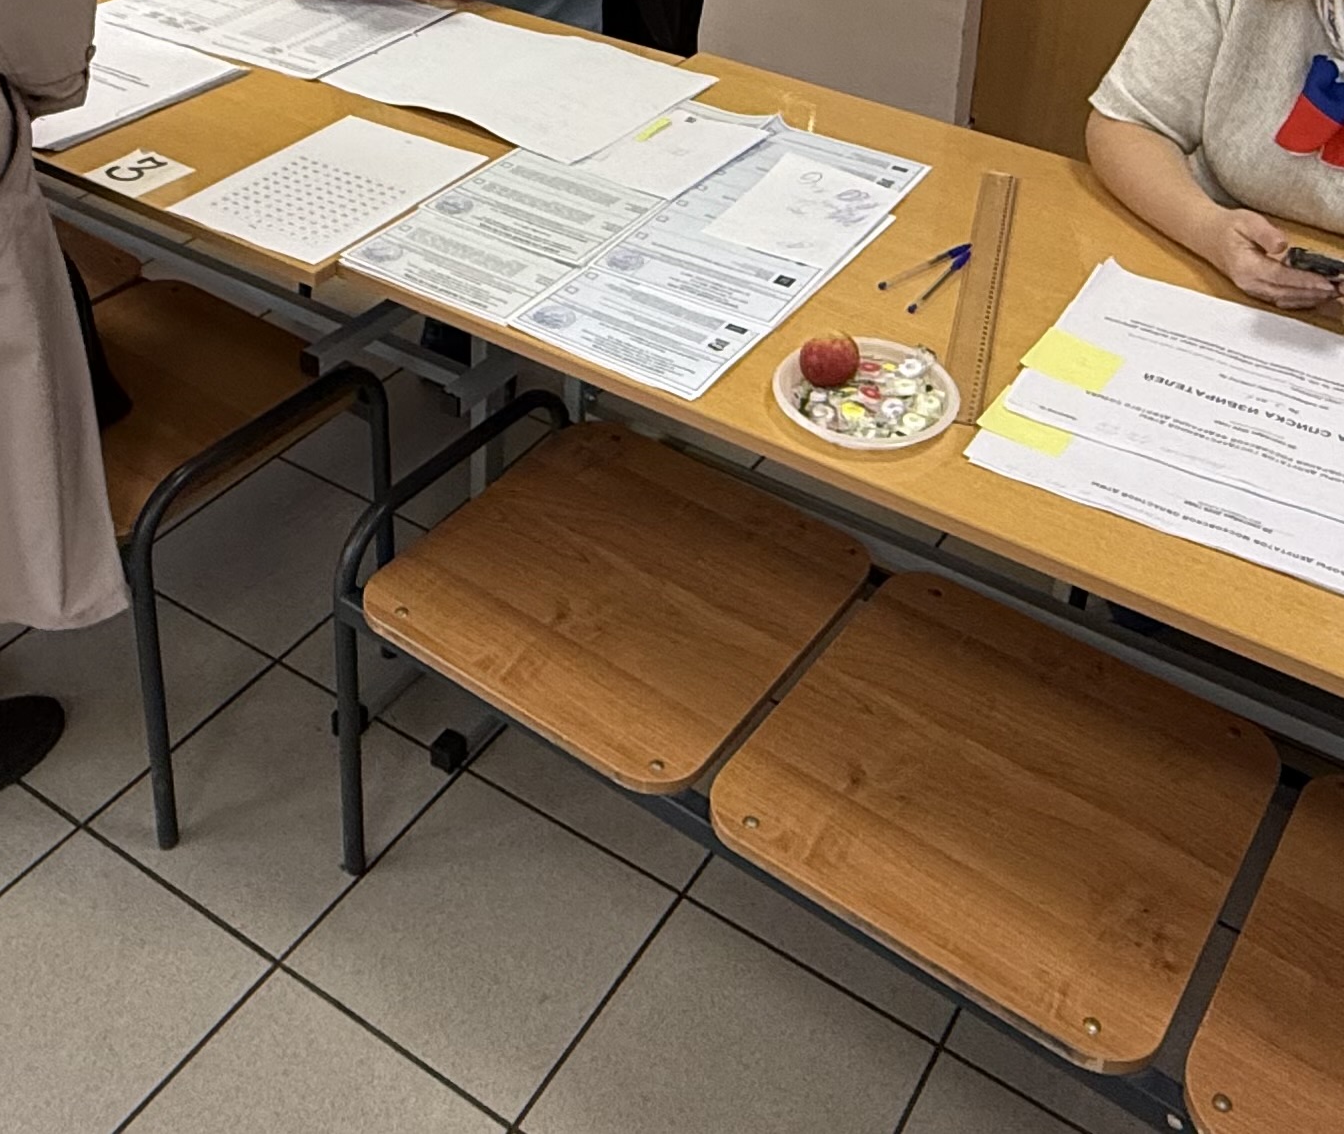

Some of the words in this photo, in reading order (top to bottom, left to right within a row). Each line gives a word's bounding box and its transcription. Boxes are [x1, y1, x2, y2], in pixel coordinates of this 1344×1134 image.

[104, 156, 169, 182] 3
[1143, 372, 1259, 415] ИЗБИРАТЕЛЕЙ
[1264, 410, 1331, 437] СПИСКА
